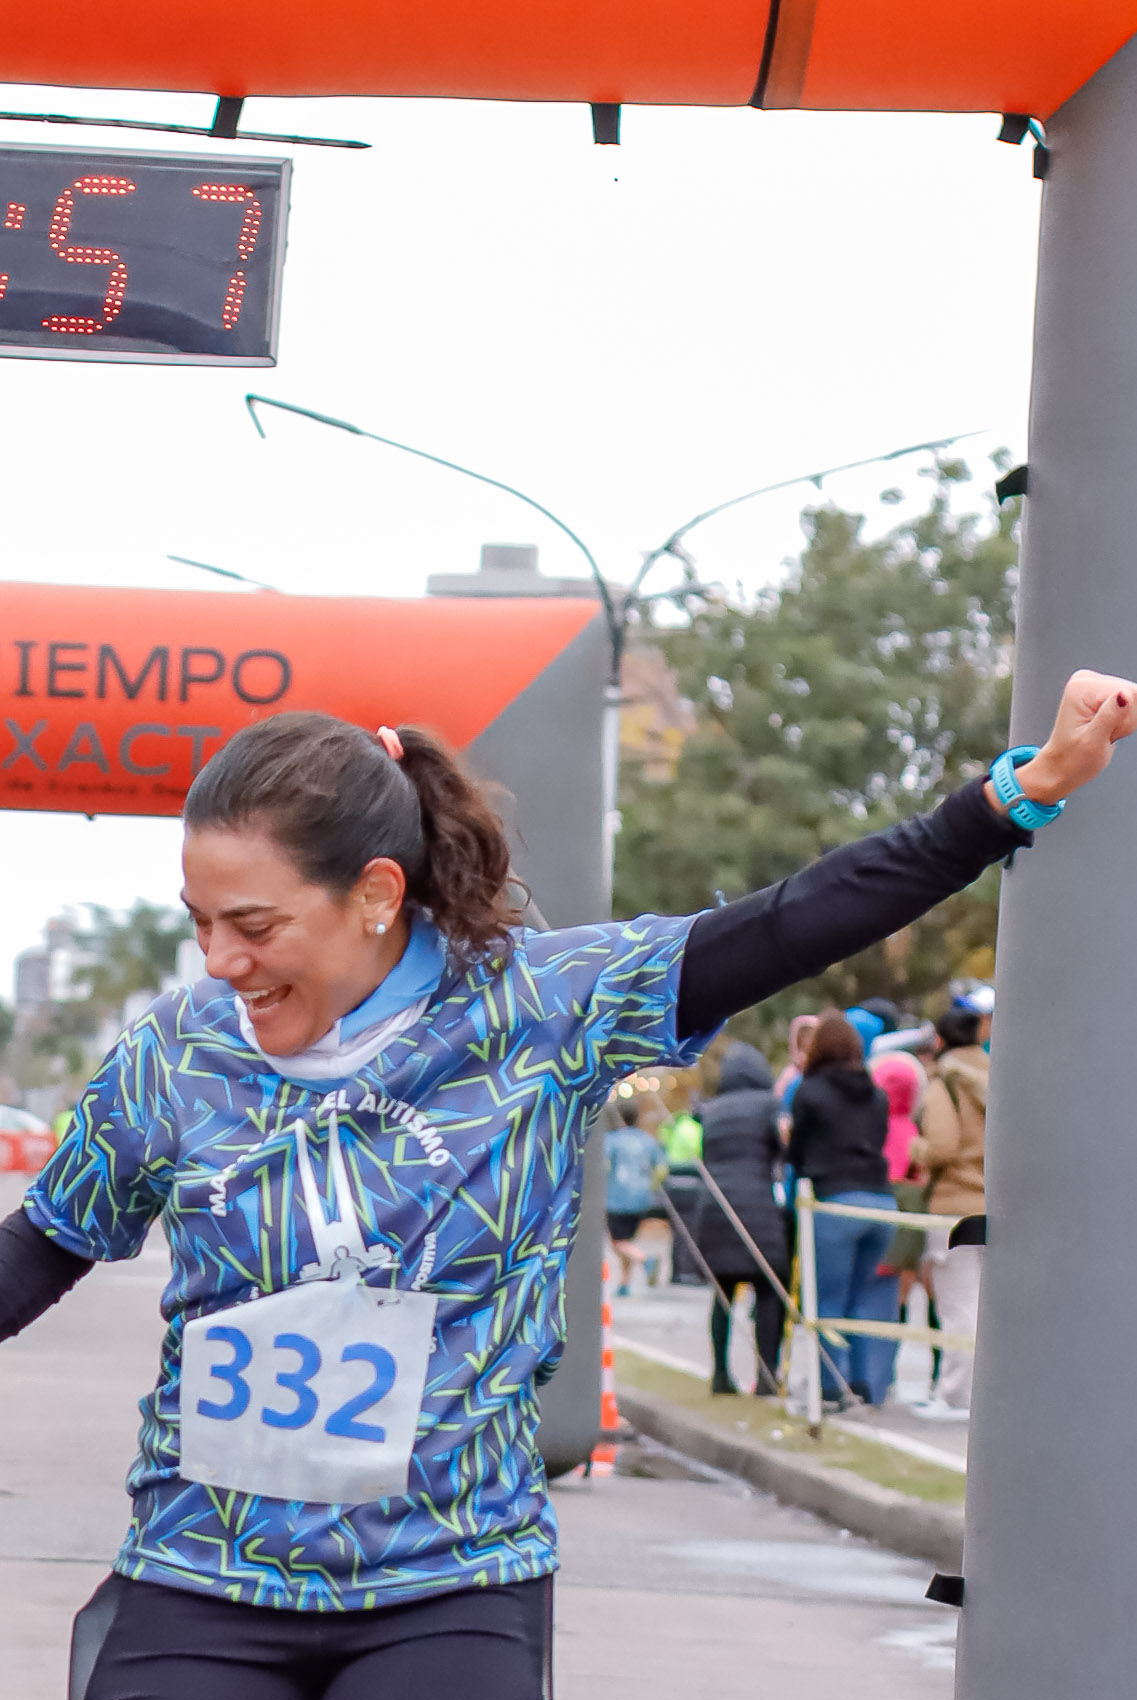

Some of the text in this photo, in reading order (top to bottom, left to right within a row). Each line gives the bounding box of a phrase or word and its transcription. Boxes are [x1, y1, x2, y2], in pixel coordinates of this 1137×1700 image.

[323, 1088, 451, 1168] EL AUTISMO
[196, 1325, 398, 1444] 332
